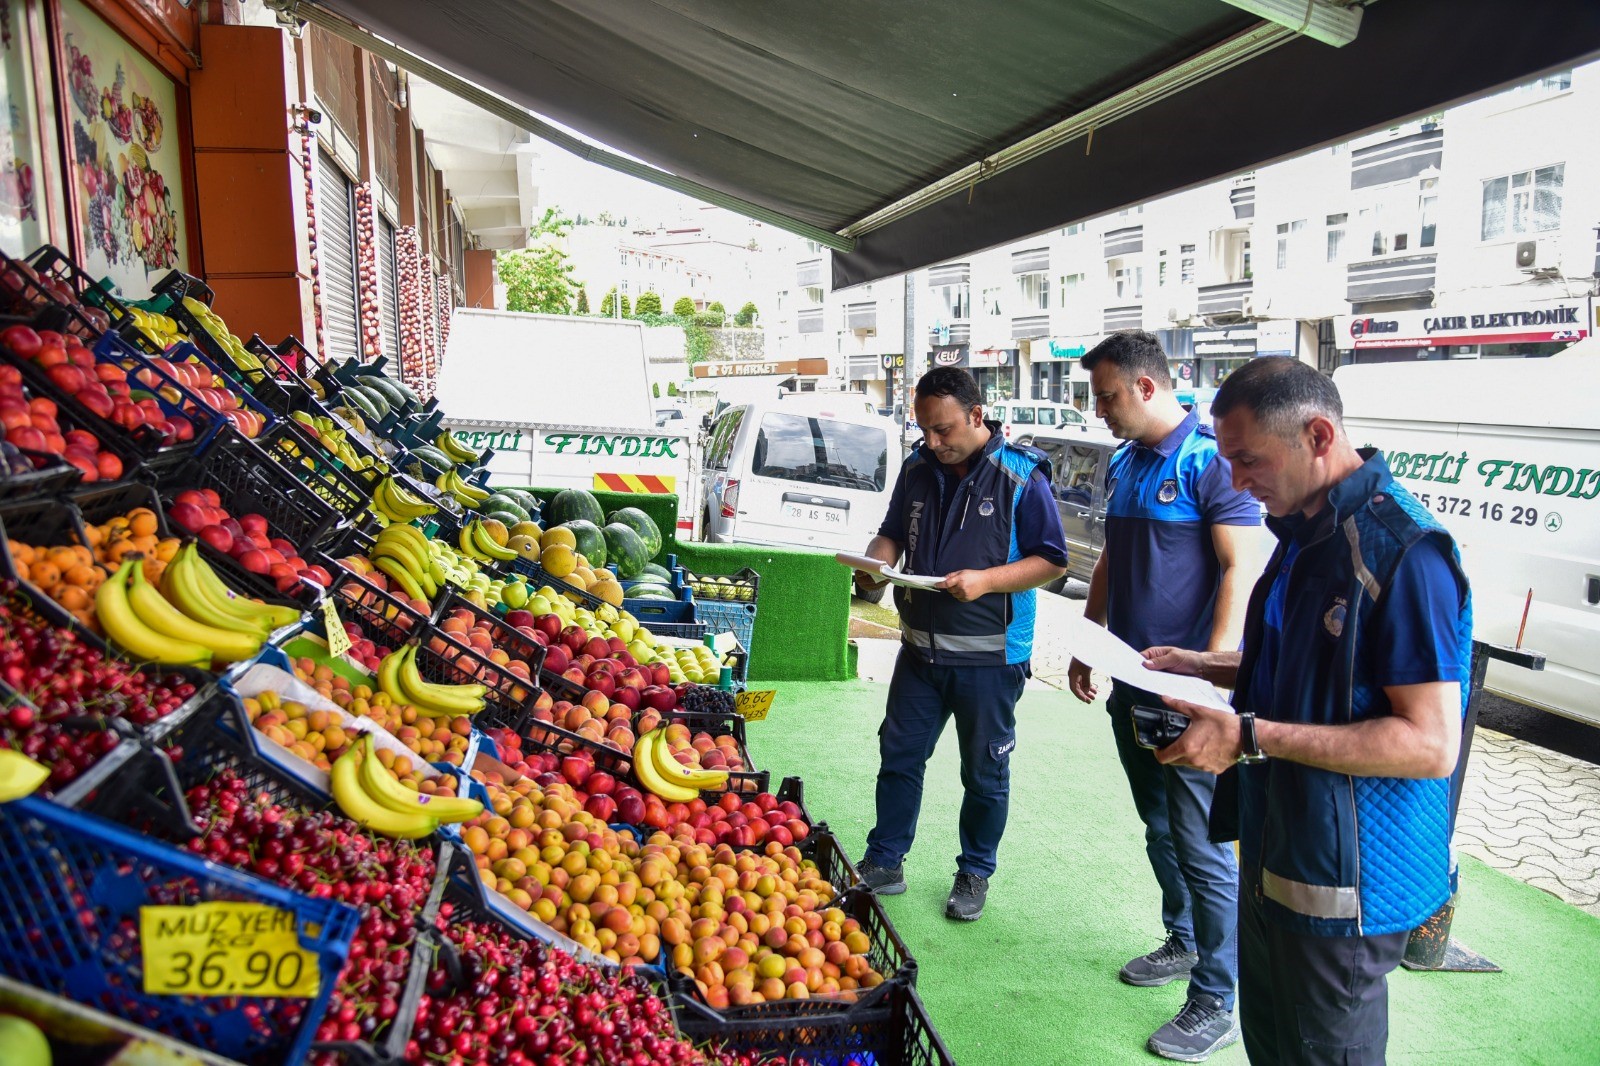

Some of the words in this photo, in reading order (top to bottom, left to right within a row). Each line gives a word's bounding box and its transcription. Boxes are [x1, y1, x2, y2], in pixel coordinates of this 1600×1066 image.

[1423, 315, 1468, 334] ÇAKIR
[1471, 304, 1579, 329] ELEKTRONİK
[735, 363, 779, 376] MARKET
[544, 433, 681, 459] FINDIK
[791, 508, 802, 518] 28
[808, 510, 819, 520] AS
[825, 512, 840, 522] 594
[1436, 495, 1472, 517] 372
[1479, 501, 1503, 521] 16
[1510, 505, 1538, 526] 29
[156, 911, 229, 938] MUZ
[237, 910, 298, 933] YERL
